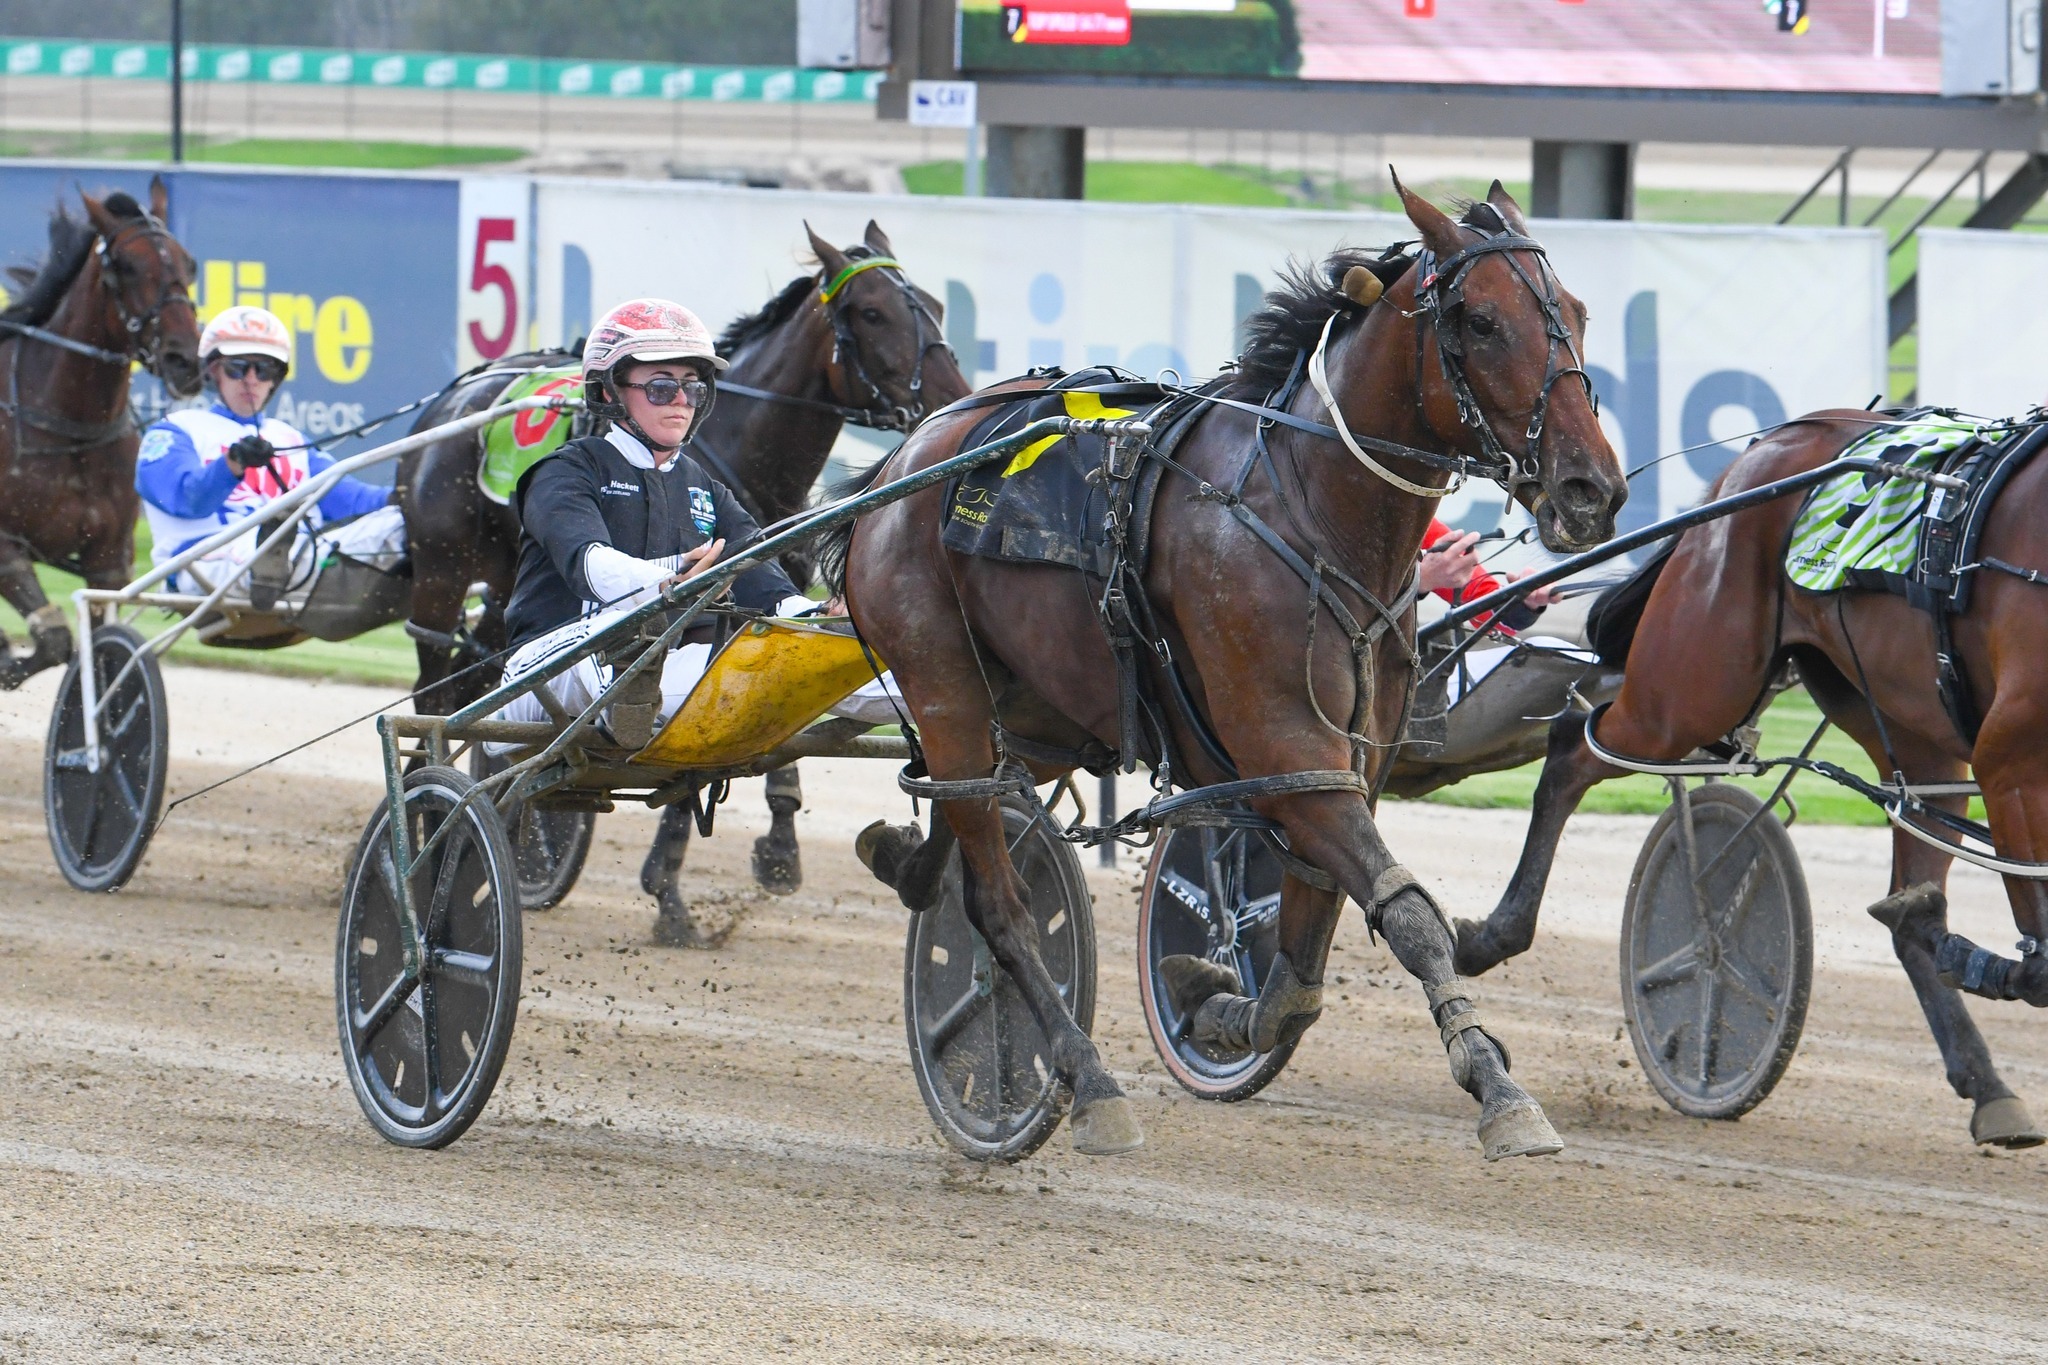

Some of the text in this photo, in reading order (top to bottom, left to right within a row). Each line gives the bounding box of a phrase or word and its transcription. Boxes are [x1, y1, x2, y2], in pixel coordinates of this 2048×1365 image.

[469, 218, 517, 360] 5
[274, 390, 366, 435] Areas
[610, 480, 639, 492] Hackett
[954, 505, 978, 520] ness
